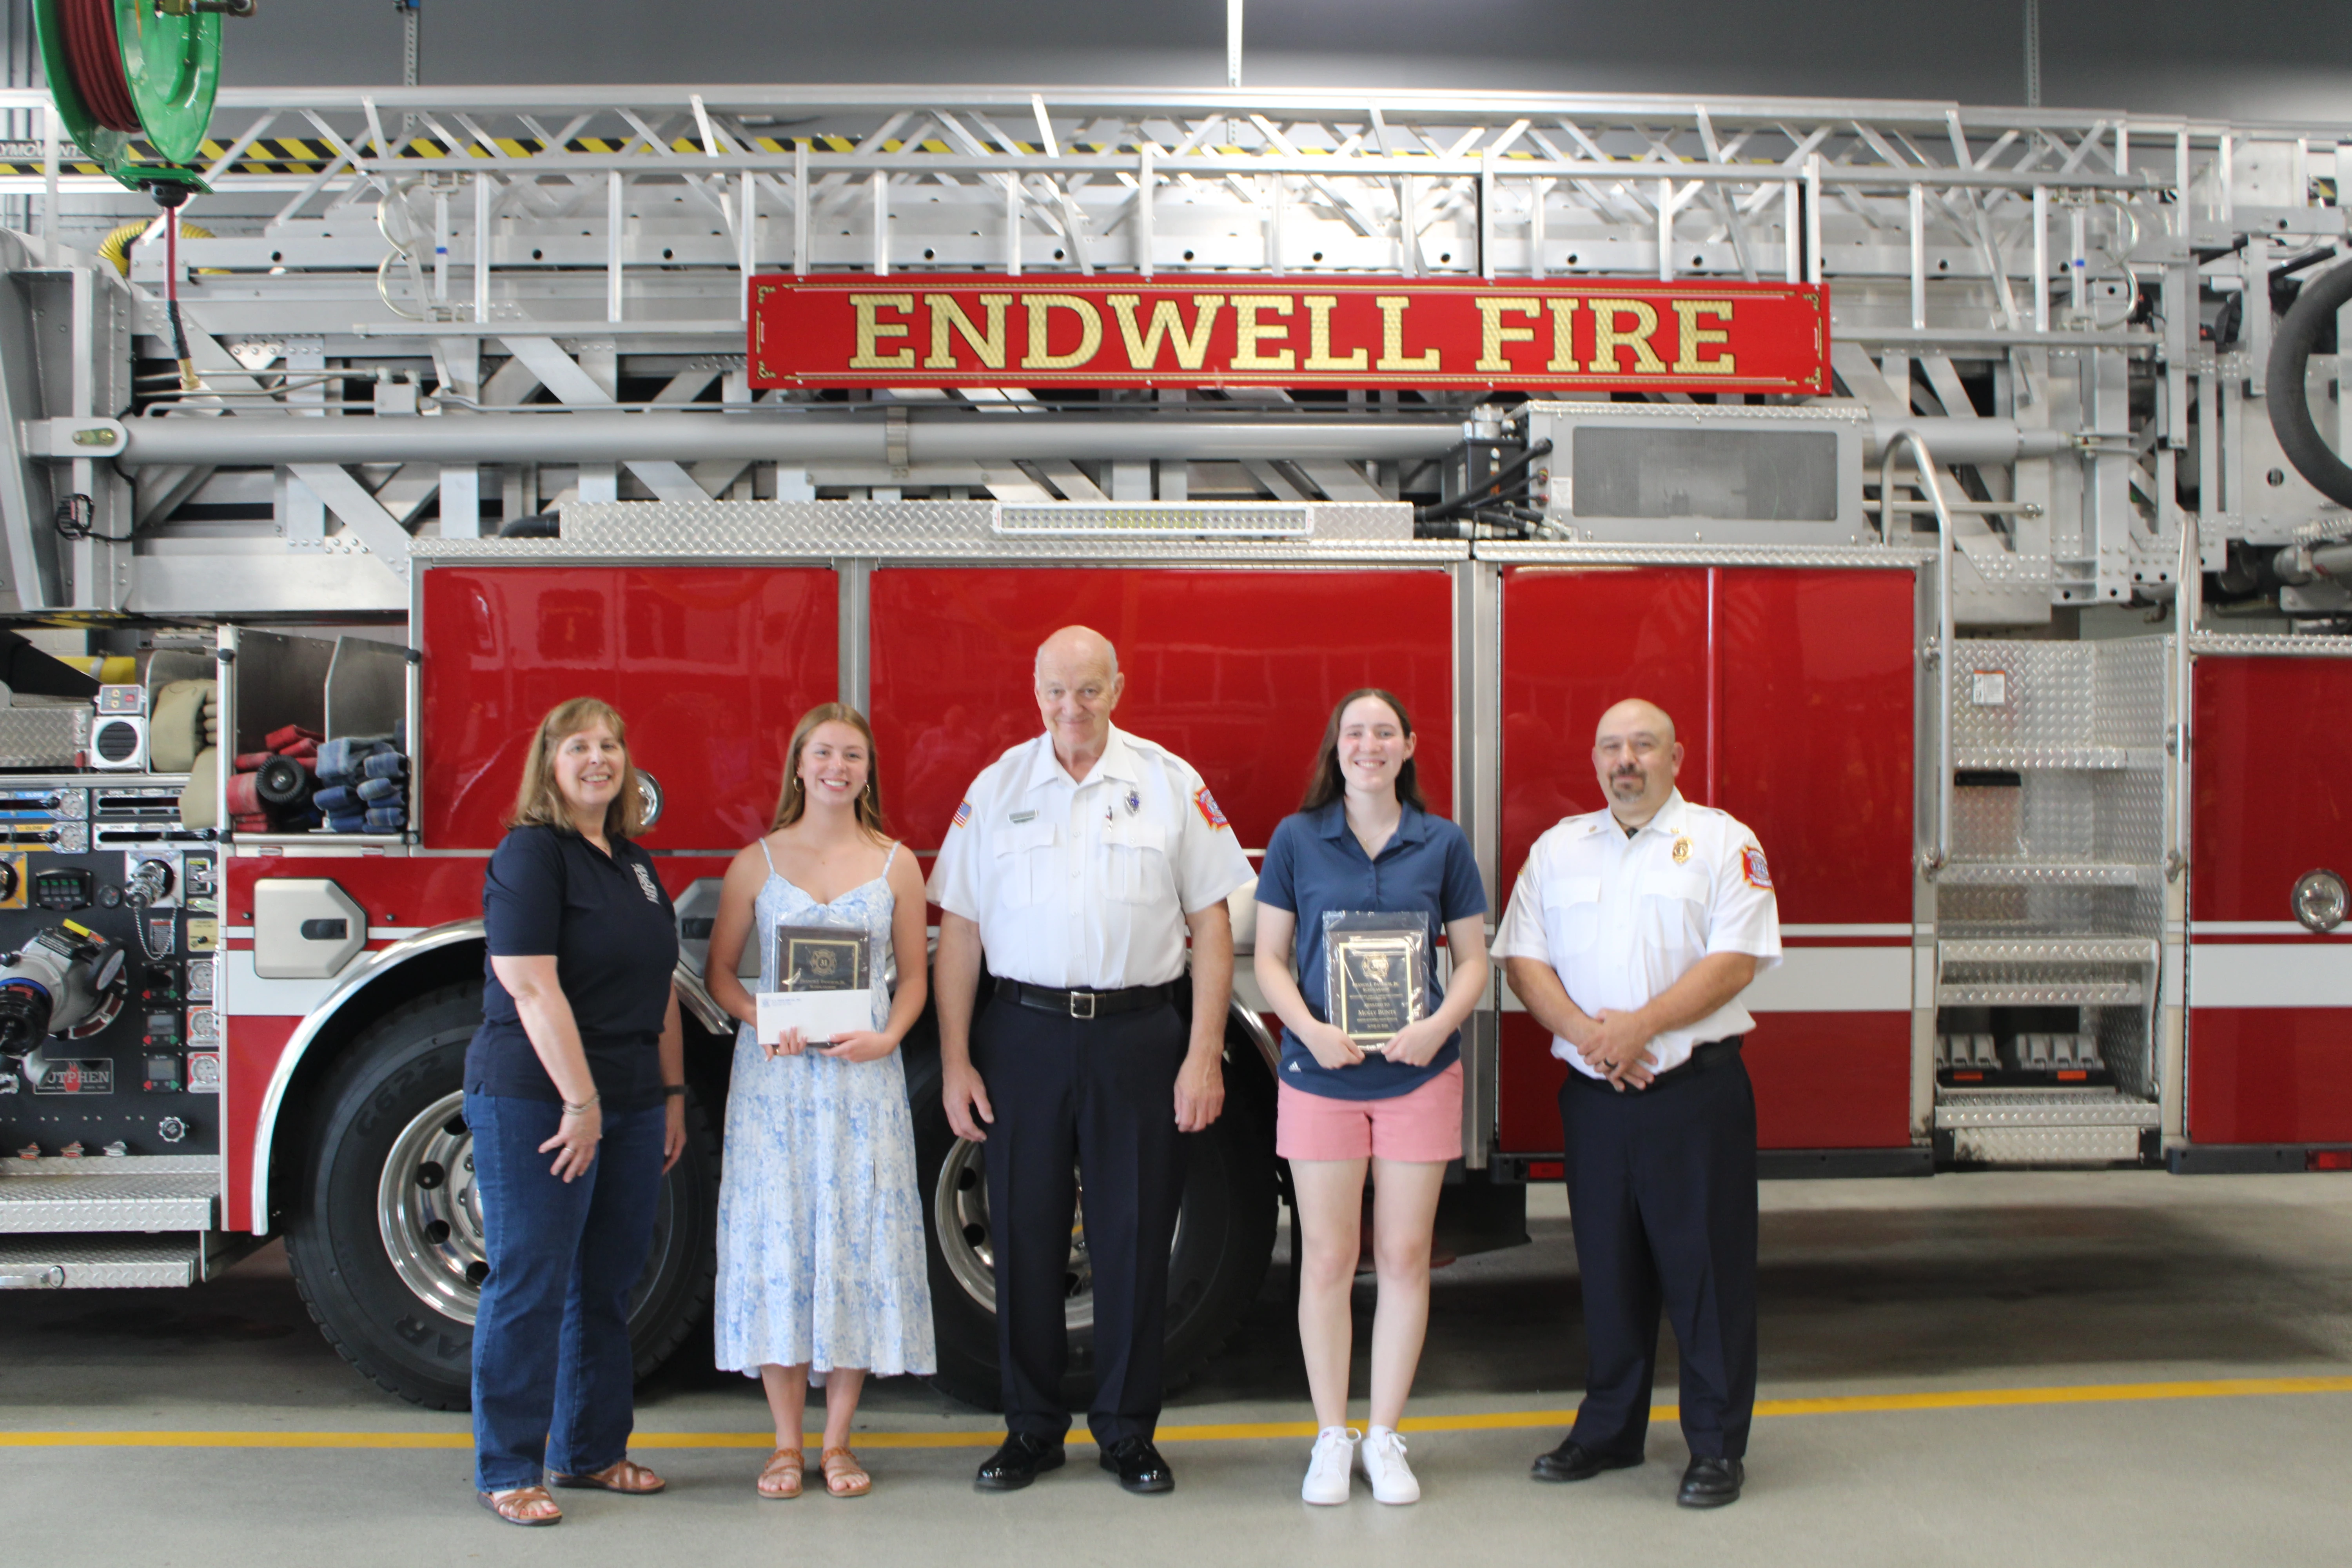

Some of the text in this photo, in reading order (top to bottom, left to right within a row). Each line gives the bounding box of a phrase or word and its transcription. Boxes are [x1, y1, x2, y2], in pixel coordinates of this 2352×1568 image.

[848, 293, 1735, 374] ENDWELL FIRE
[47, 1071, 110, 1083] UTPHEN
